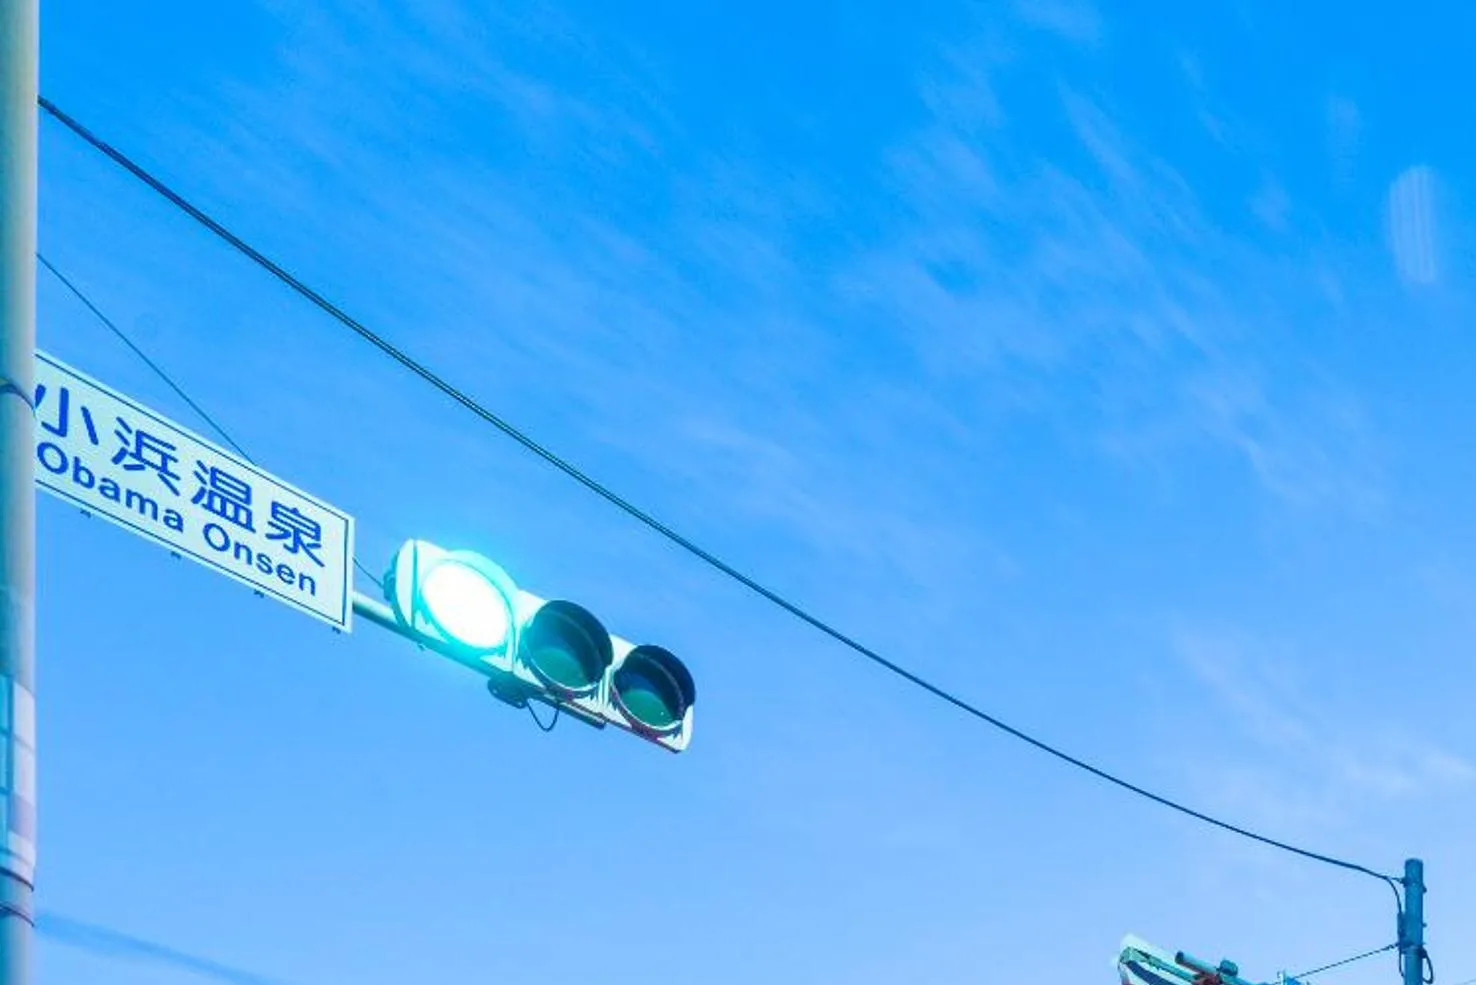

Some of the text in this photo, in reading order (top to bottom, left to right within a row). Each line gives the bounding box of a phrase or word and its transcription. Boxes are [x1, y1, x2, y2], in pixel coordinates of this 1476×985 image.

[35, 384, 325, 568] 小浜温泉
[37, 441, 316, 596] Obama Onsen
